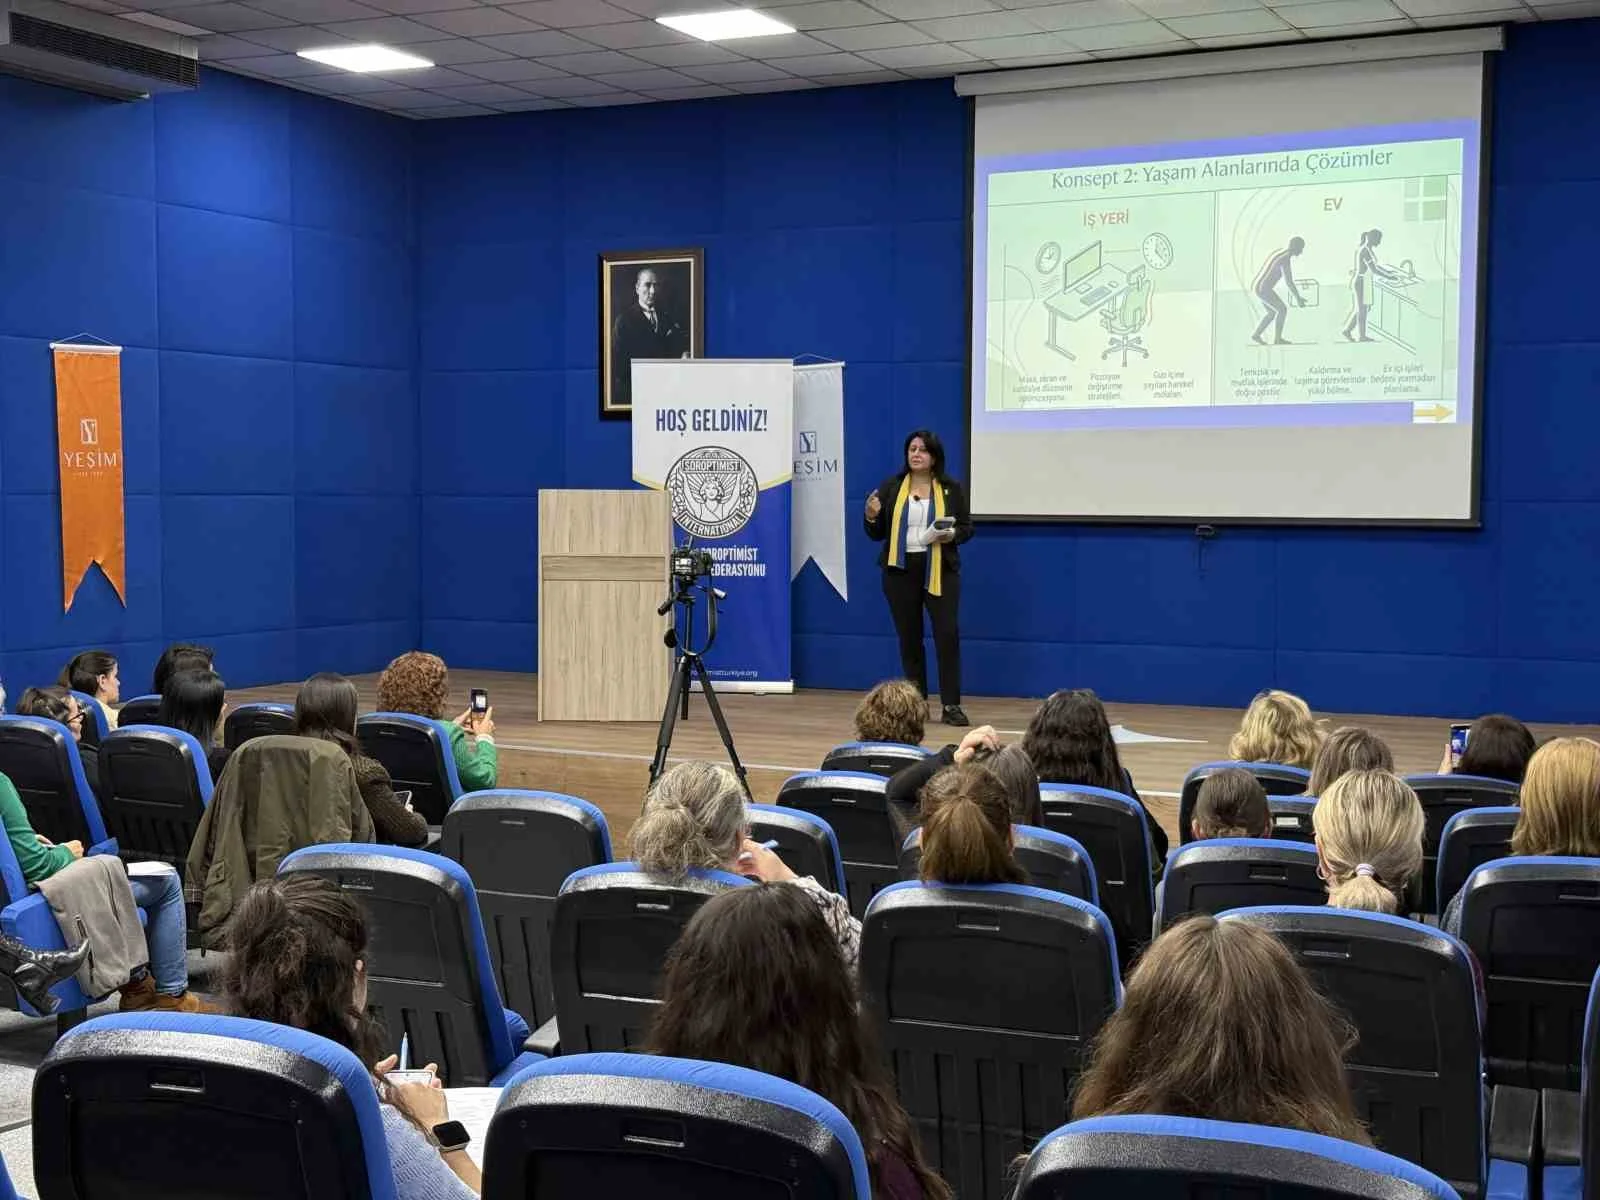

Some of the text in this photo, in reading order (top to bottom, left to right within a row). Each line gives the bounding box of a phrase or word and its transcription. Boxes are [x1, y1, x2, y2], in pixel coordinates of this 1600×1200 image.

[1052, 149, 1393, 189] Konsept 2: Yaşam Alanlarında Çözümler
[1323, 197, 1343, 212] EV
[1099, 208, 1129, 225] YERİ
[656, 403, 768, 436] HOŞ GELDİNİZ!
[684, 460, 740, 471] SOROPTIMIST
[793, 456, 838, 475] EŞİM
[680, 513, 745, 537] INTERNATIONAL
[701, 545, 758, 561] OROPTİMİST
[711, 563, 766, 576] EDERASYONU
